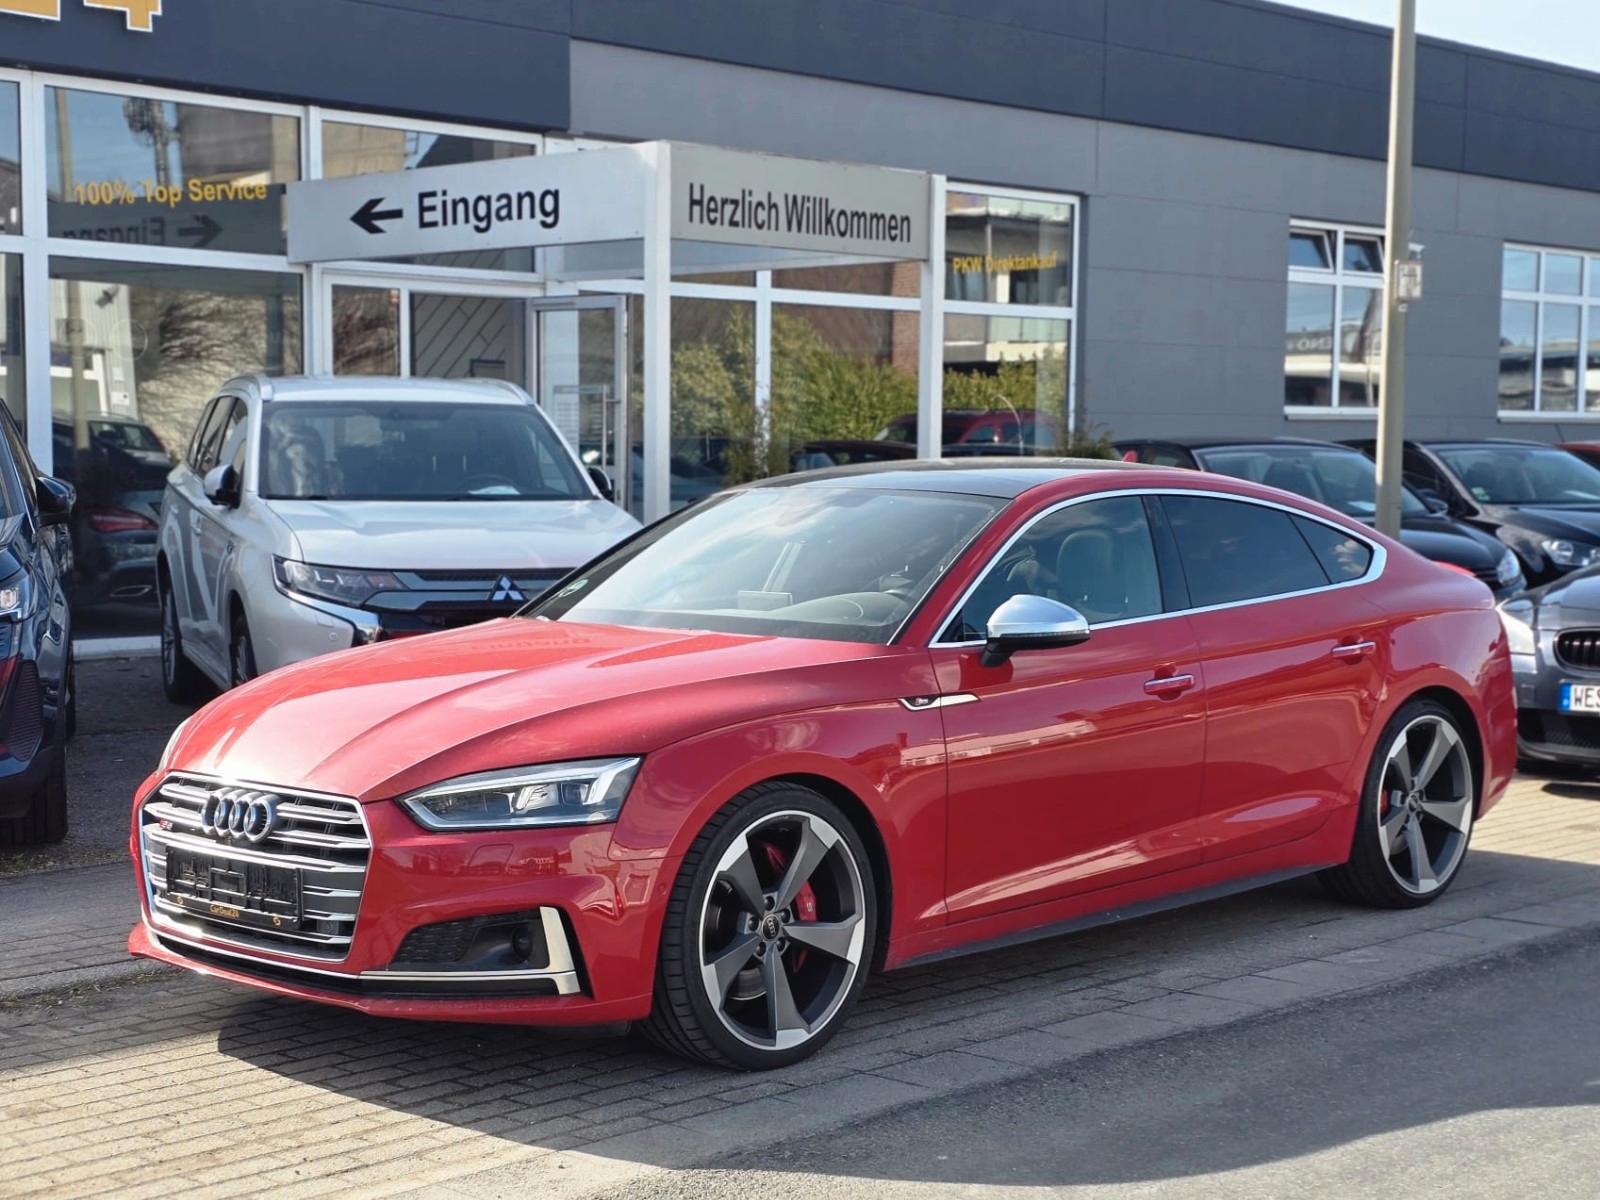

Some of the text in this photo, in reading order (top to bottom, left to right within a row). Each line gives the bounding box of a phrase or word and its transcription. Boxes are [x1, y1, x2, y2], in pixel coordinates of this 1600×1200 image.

[75, 178, 267, 208] 100% Top Service
[418, 188, 560, 234] Eingang
[688, 182, 912, 243] Herzlich Willkommen
[952, 250, 1057, 273] PKW Direktankauf
